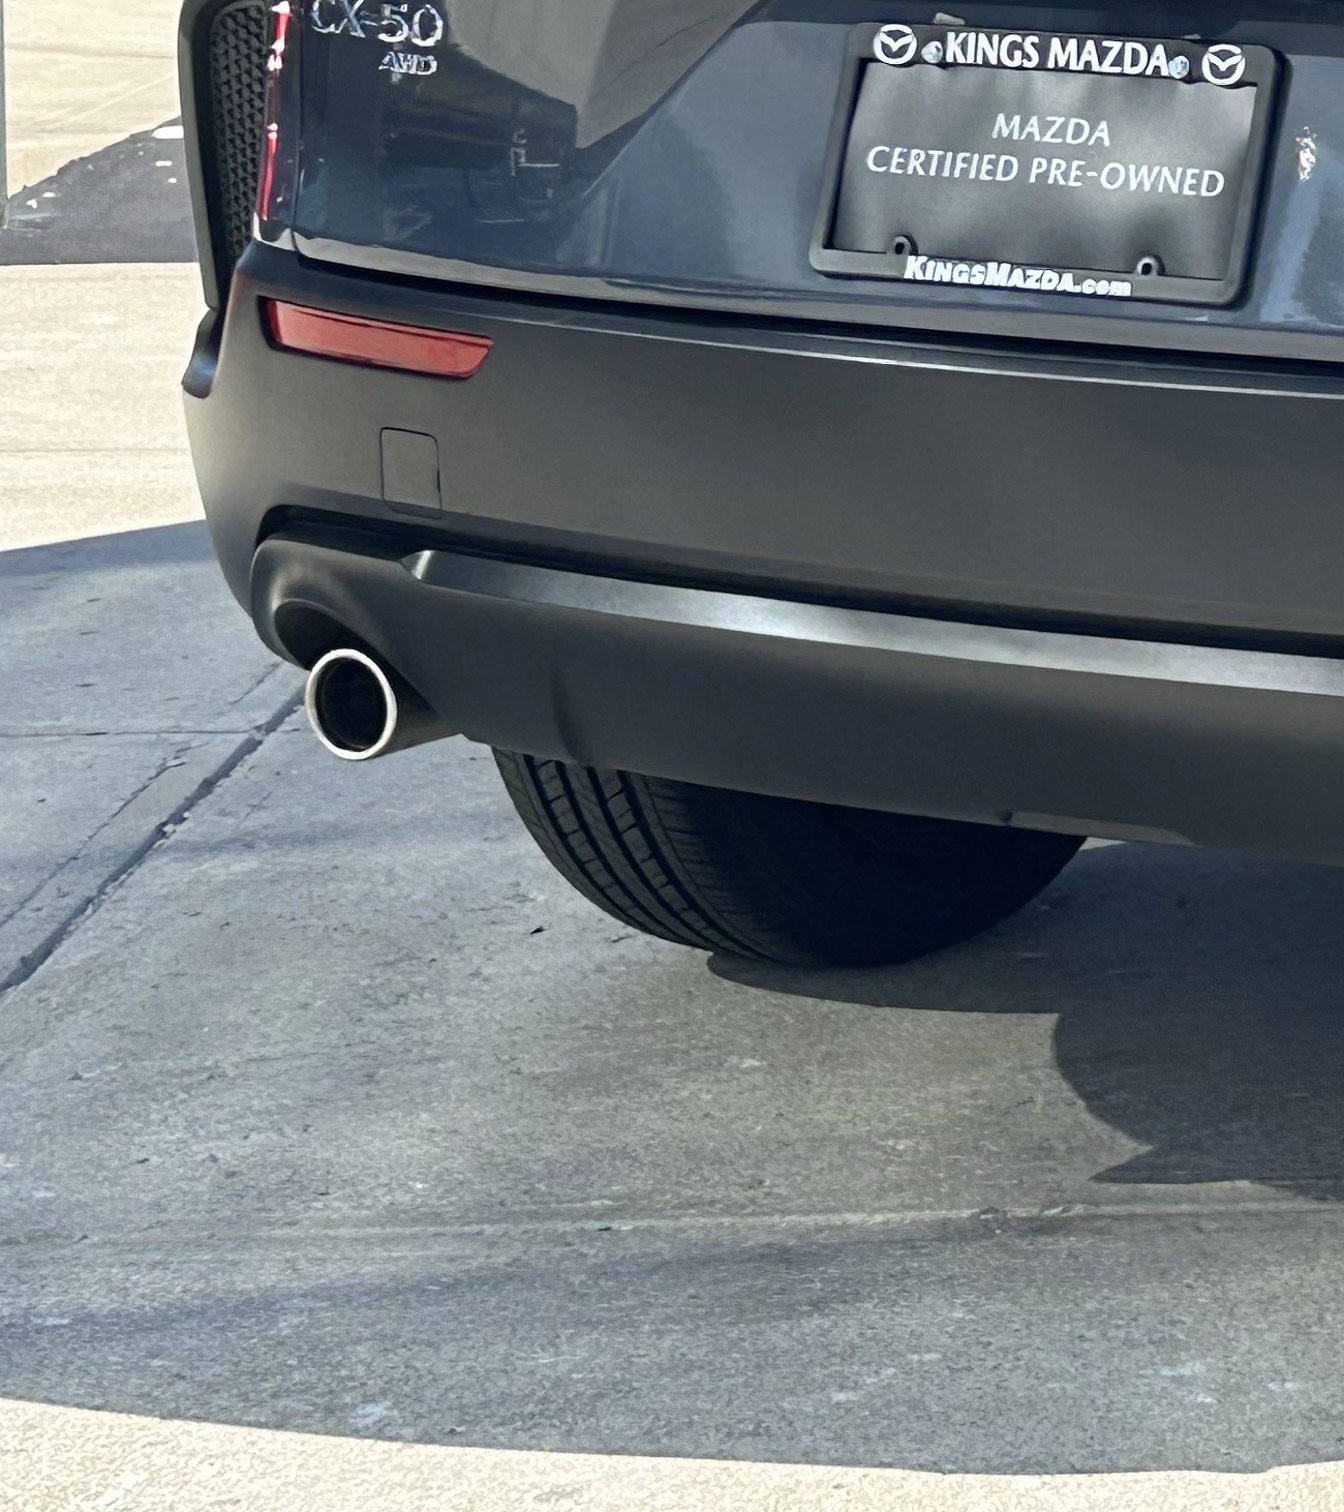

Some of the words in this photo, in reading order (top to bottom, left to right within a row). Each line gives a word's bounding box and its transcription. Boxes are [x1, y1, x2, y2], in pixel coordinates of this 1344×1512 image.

[944, 31, 1039, 68] KINGS
[1047, 37, 1170, 77] MAZDA
[991, 112, 1111, 147] MAZDA
[865, 144, 1019, 183] CERTIFIED
[1027, 156, 1225, 198] PRE-OWNED
